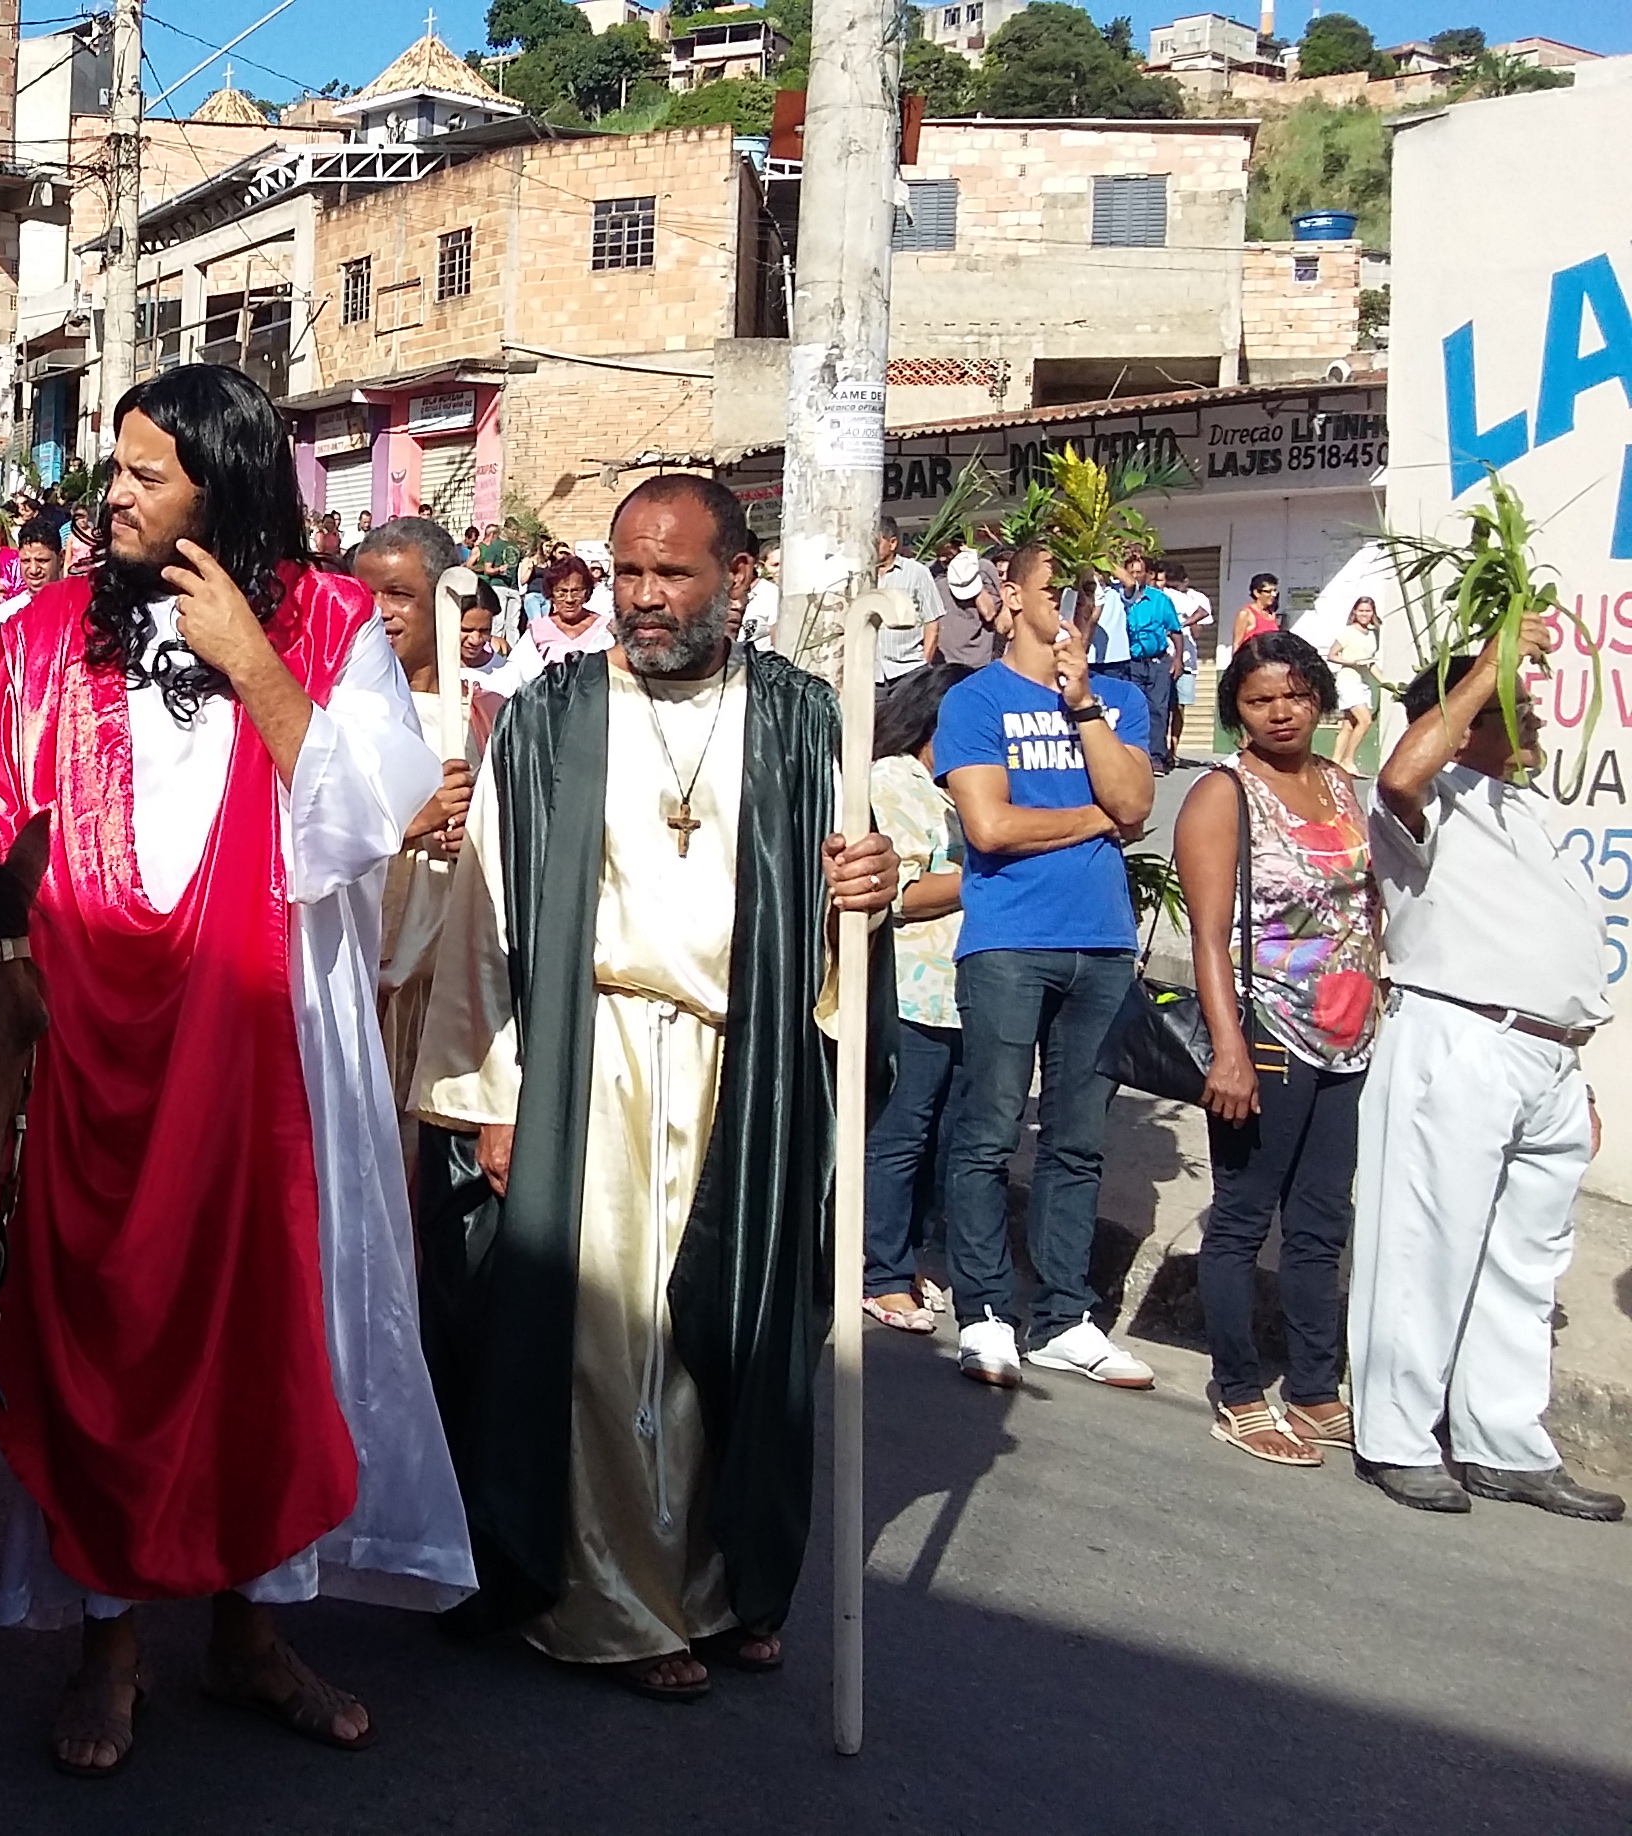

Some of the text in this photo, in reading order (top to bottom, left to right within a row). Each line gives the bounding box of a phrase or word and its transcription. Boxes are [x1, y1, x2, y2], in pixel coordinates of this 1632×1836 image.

[831, 390, 882, 401] XAME DE
[1207, 448, 1283, 478] LAJES
[883, 457, 953, 502] BAR
